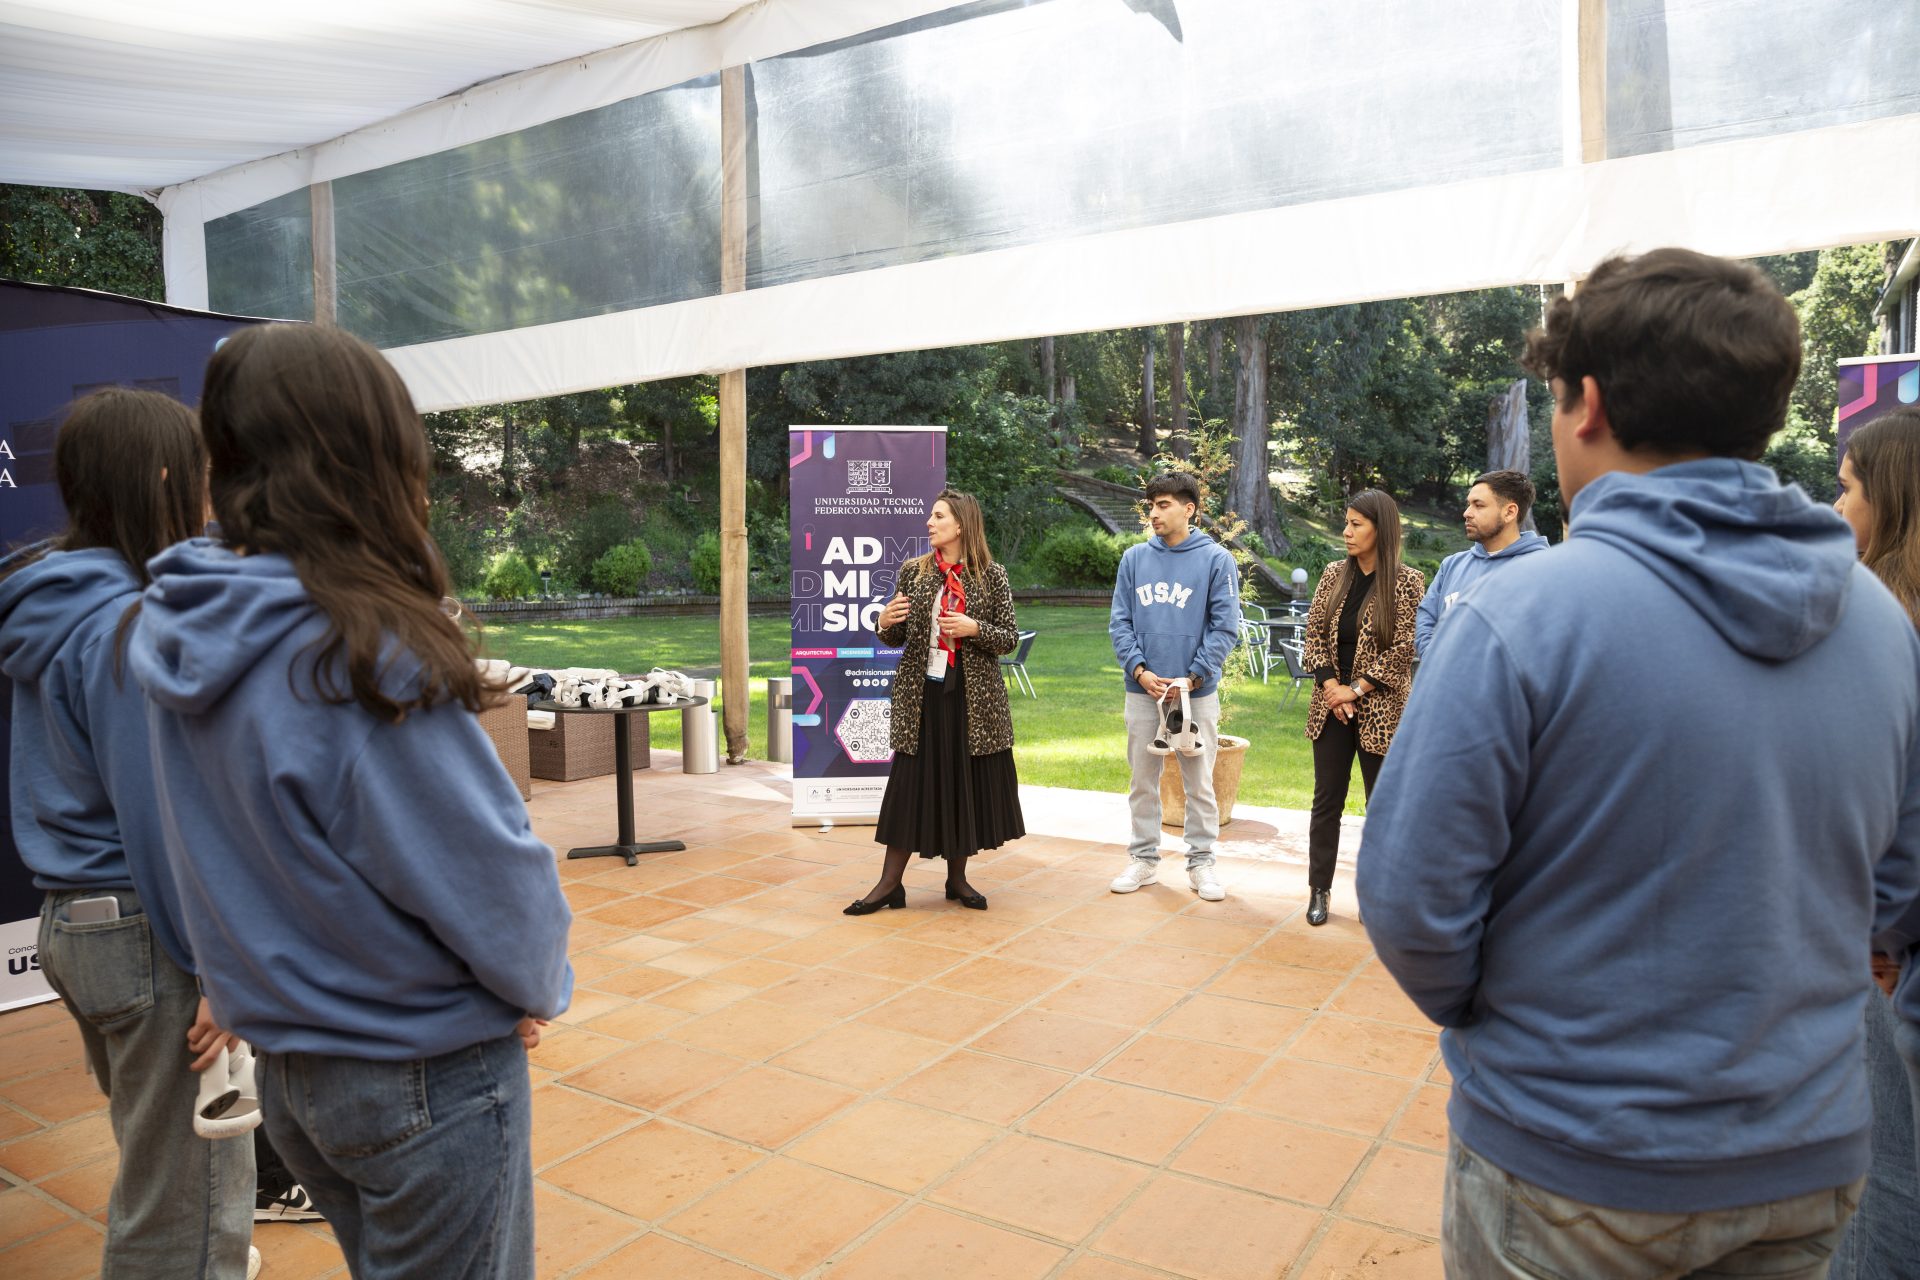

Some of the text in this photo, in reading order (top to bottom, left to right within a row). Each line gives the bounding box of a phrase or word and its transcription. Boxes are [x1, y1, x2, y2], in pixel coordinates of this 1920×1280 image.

[814, 497, 924, 506] UNIVERSIDAD TECNICA
[814, 506, 924, 515] FEDERICO SANTA MARIA
[1135, 581, 1193, 609] USM
